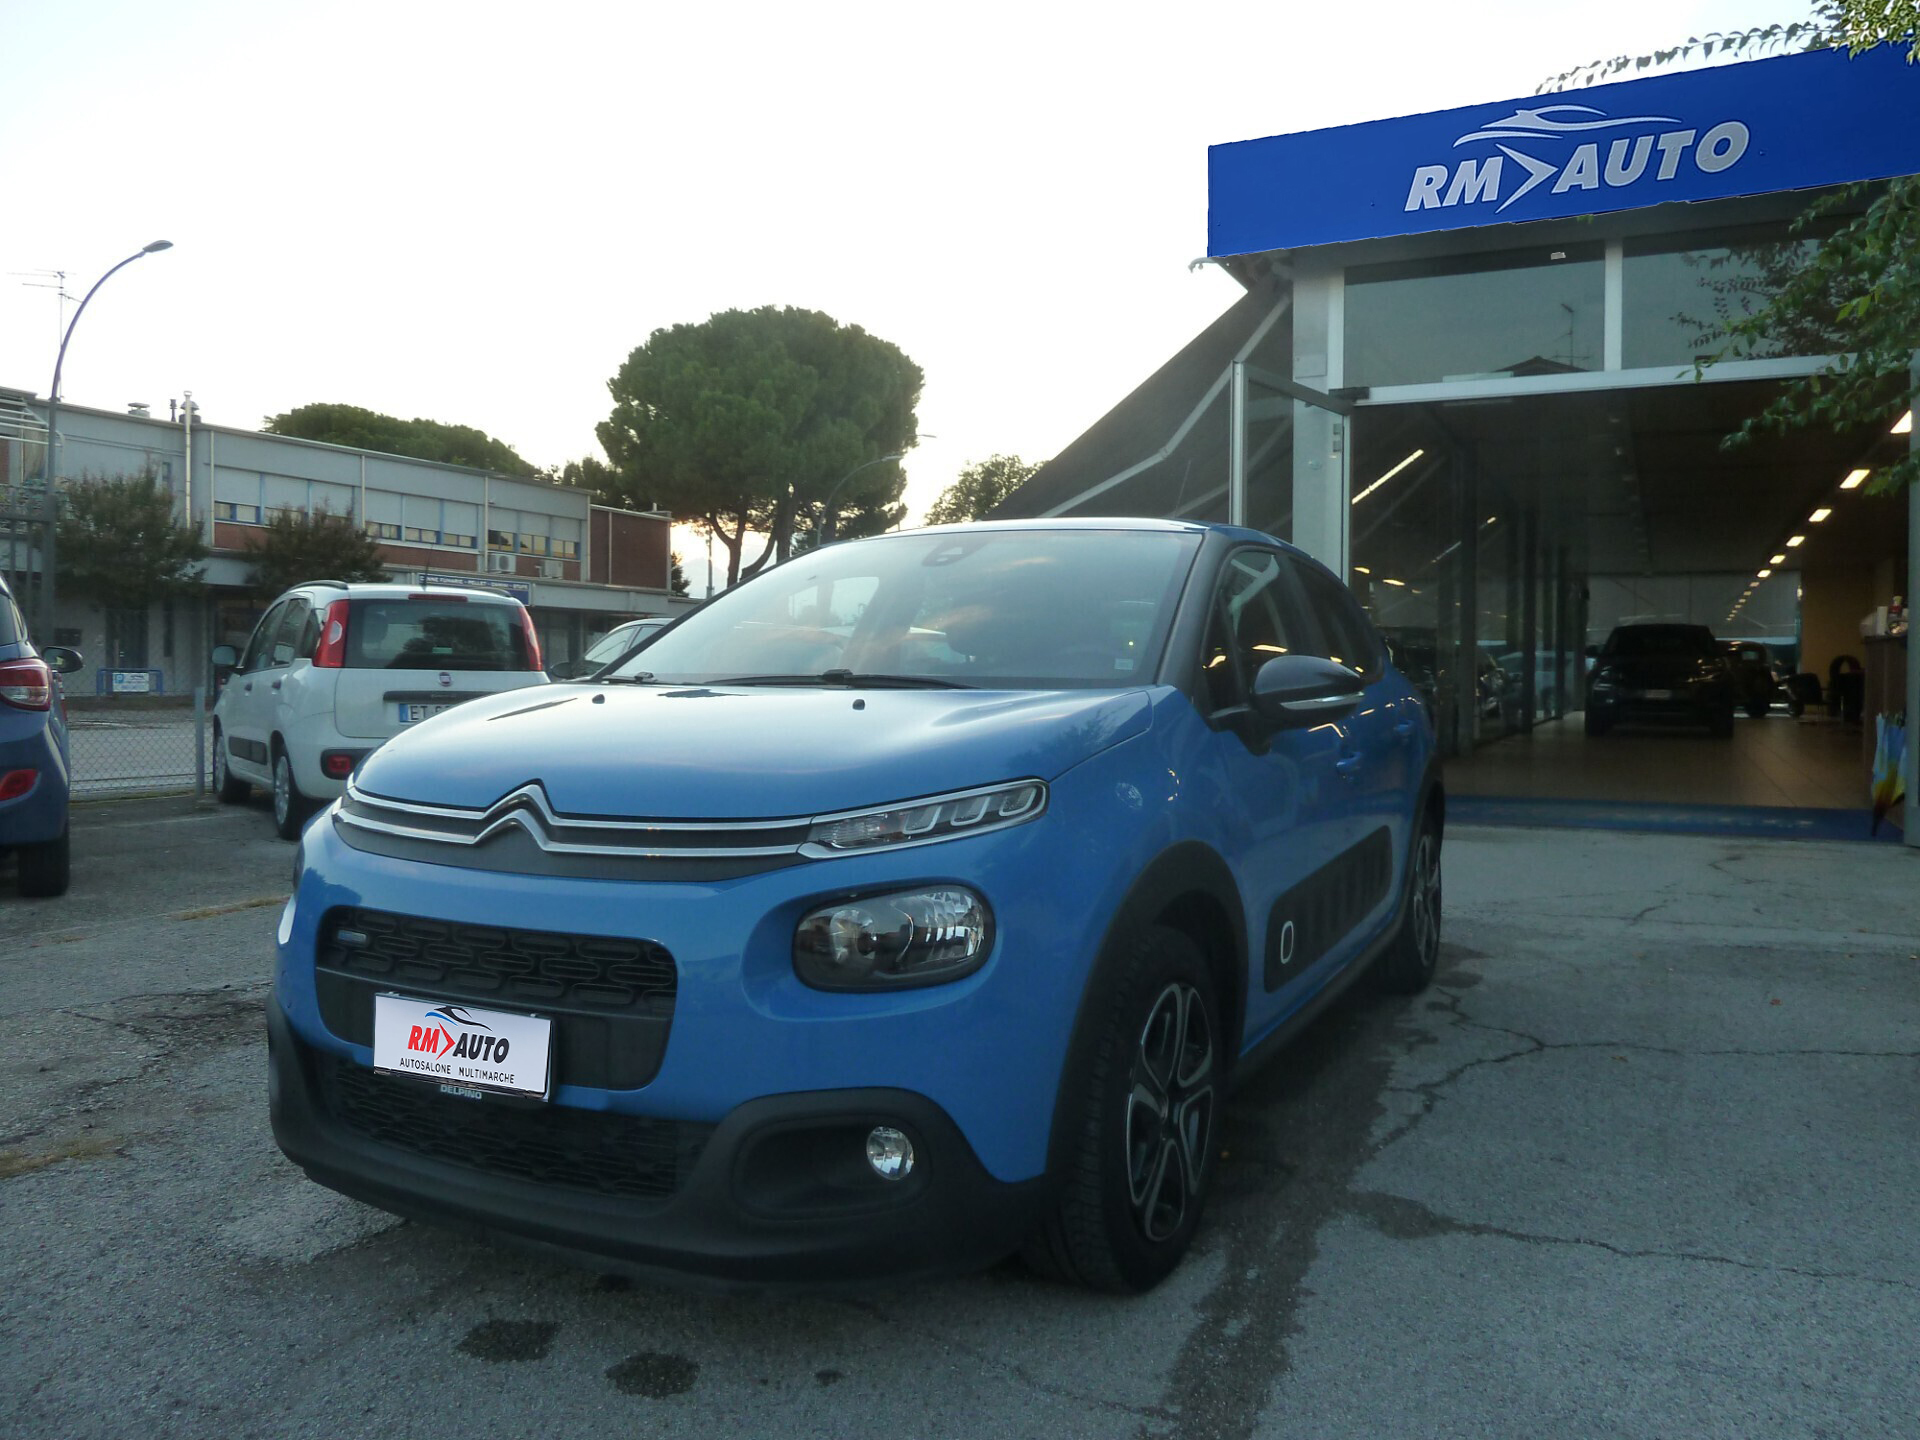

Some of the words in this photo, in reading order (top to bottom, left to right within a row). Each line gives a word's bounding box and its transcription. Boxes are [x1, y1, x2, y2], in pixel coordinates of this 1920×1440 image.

[1404, 156, 1504, 212] RM
[1551, 120, 1750, 195] AUTO
[407, 1025, 440, 1054] RM
[452, 1032, 510, 1064] AUTO
[399, 1057, 452, 1074] AUTOSALONE
[458, 1066, 515, 1084] MULTIMARCHE
[440, 1084, 482, 1100] DELPINO
